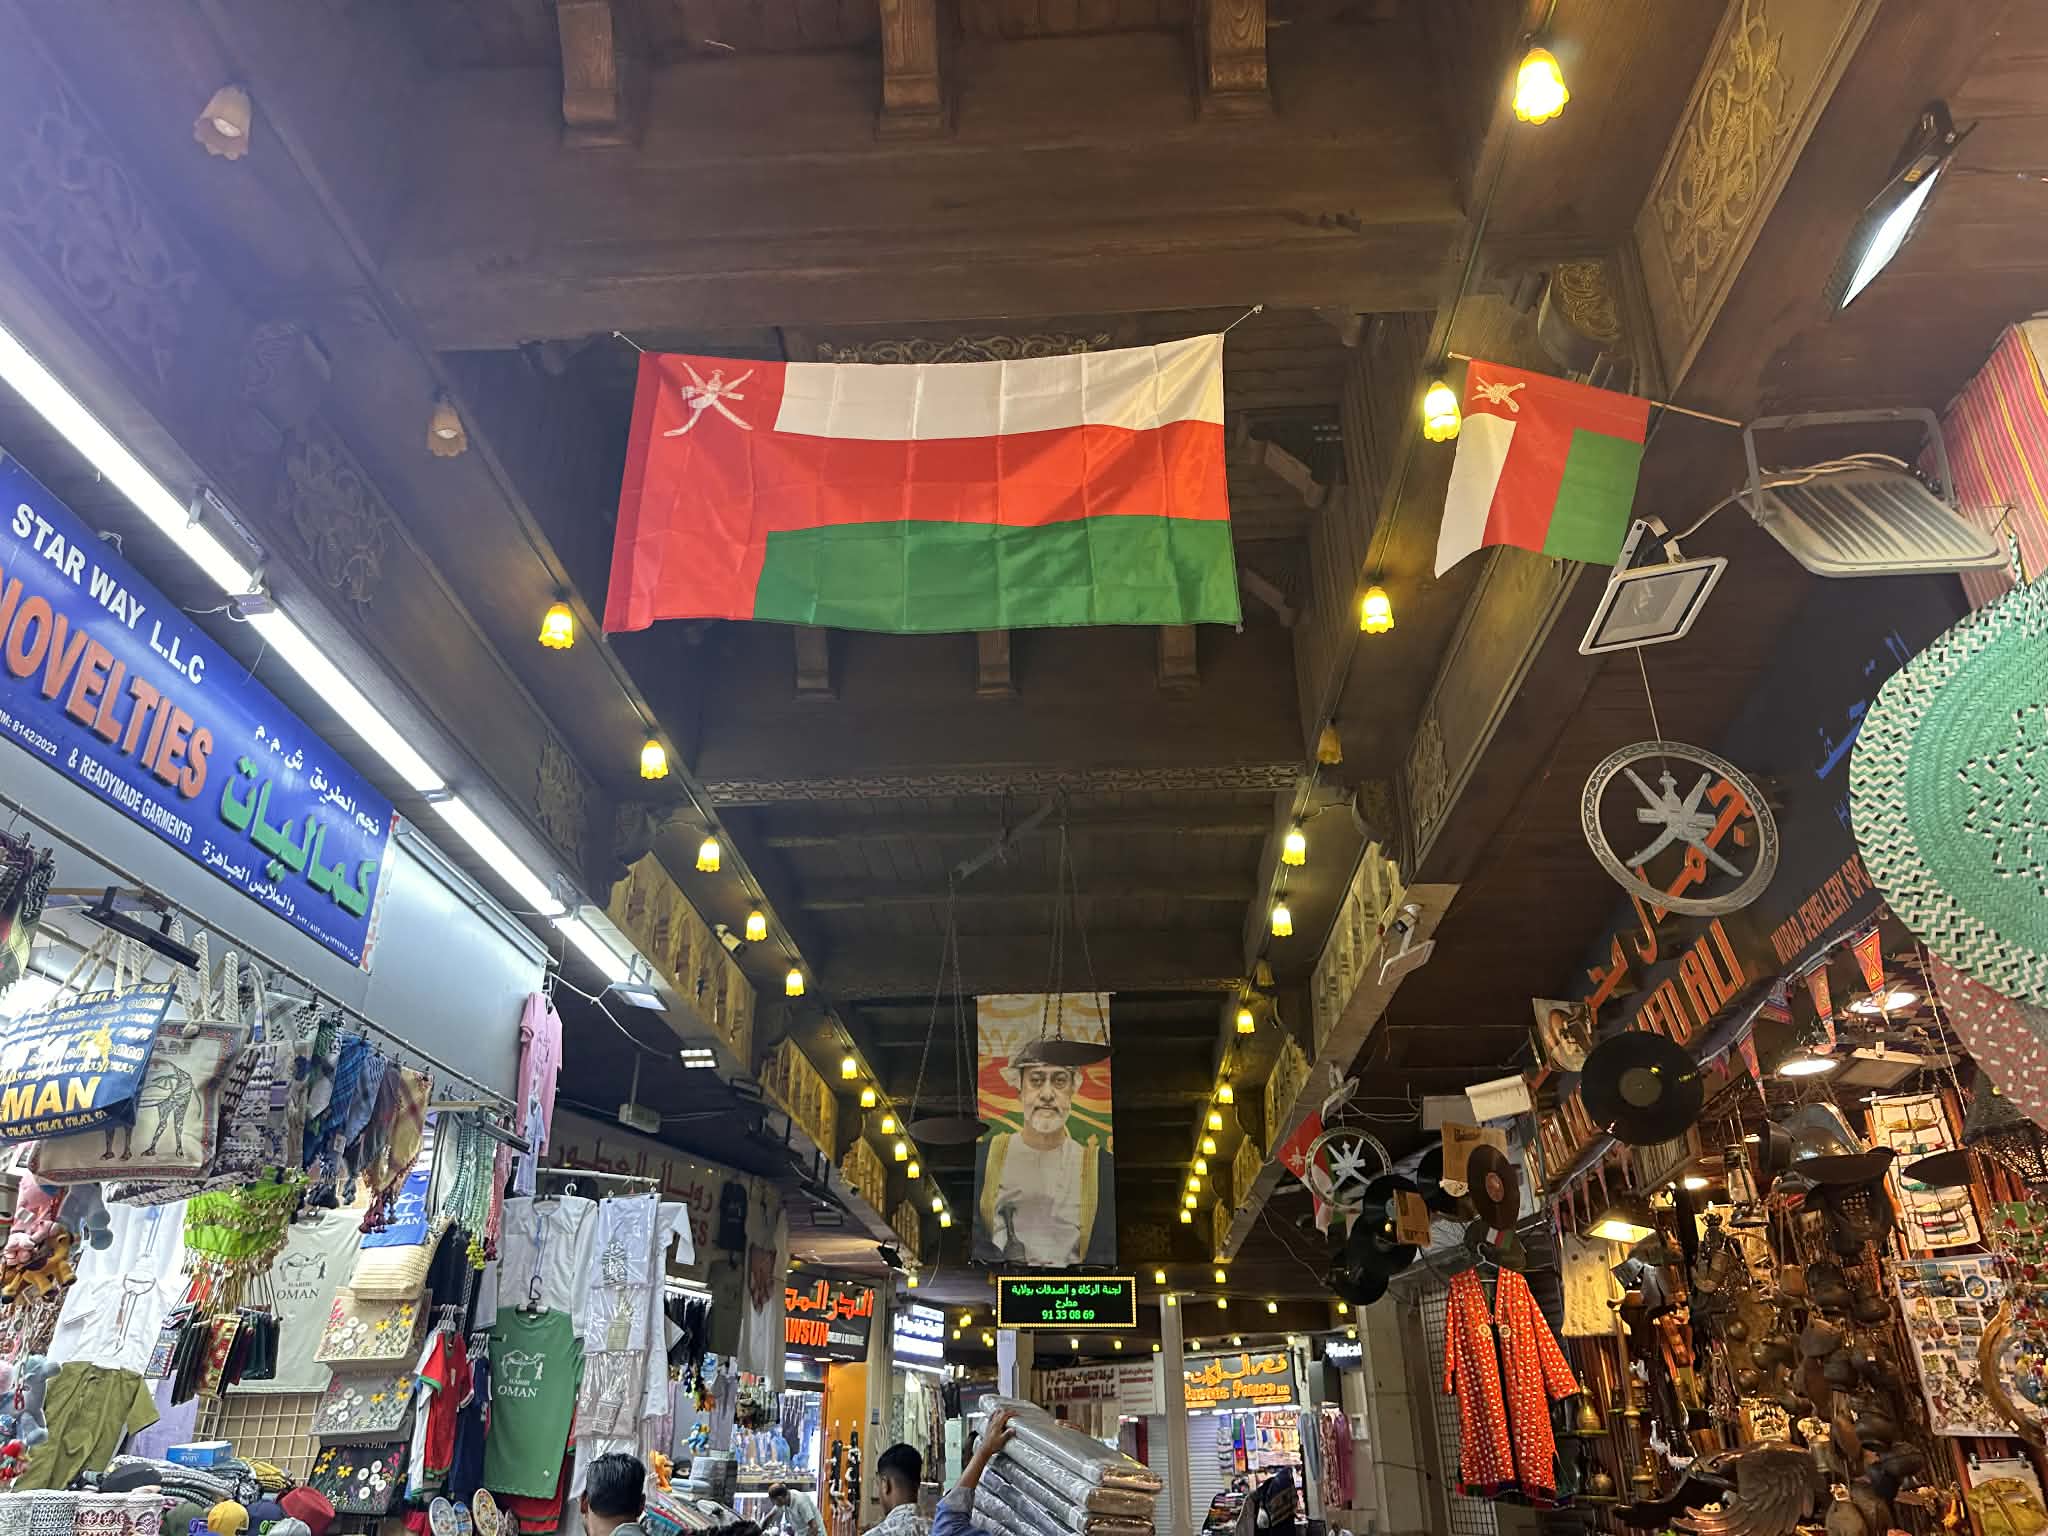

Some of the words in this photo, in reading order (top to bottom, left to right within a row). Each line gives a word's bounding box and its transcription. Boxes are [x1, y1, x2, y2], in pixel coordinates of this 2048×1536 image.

[12, 503, 86, 585] STAR
[89, 565, 147, 629] WAY
[150, 619, 205, 685] L.L.C
[12, 720, 58, 757] 8142/2022
[68, 747, 79, 769] &
[80, 755, 143, 814] READYMADE
[141, 798, 193, 845] GARMENTS
[309, 767, 356, 816] الطريق
[355, 811, 380, 837] نجم
[220, 755, 378, 920] كماليات
[201, 840, 250, 883] الجاهزة
[248, 881, 296, 918] والملابس
[1679, 918, 1746, 1026] ALI
[276, 1288, 321, 1301] OMAN
[1011, 1284, 1034, 1296] بولاية
[1035, 1284, 1069, 1295] الصدقات
[1071, 1288, 1077, 1296] و
[1077, 1283, 1100, 1296] الزكاة
[1102, 1283, 1122, 1296] لجنة
[1055, 1296, 1079, 1309] مطرح
[1041, 1309, 1054, 1320] 91
[1055, 1309, 1067, 1320] 33
[1069, 1309, 1081, 1320] 08
[1082, 1309, 1095, 1320] 69
[497, 1385, 539, 1398] OMAN
